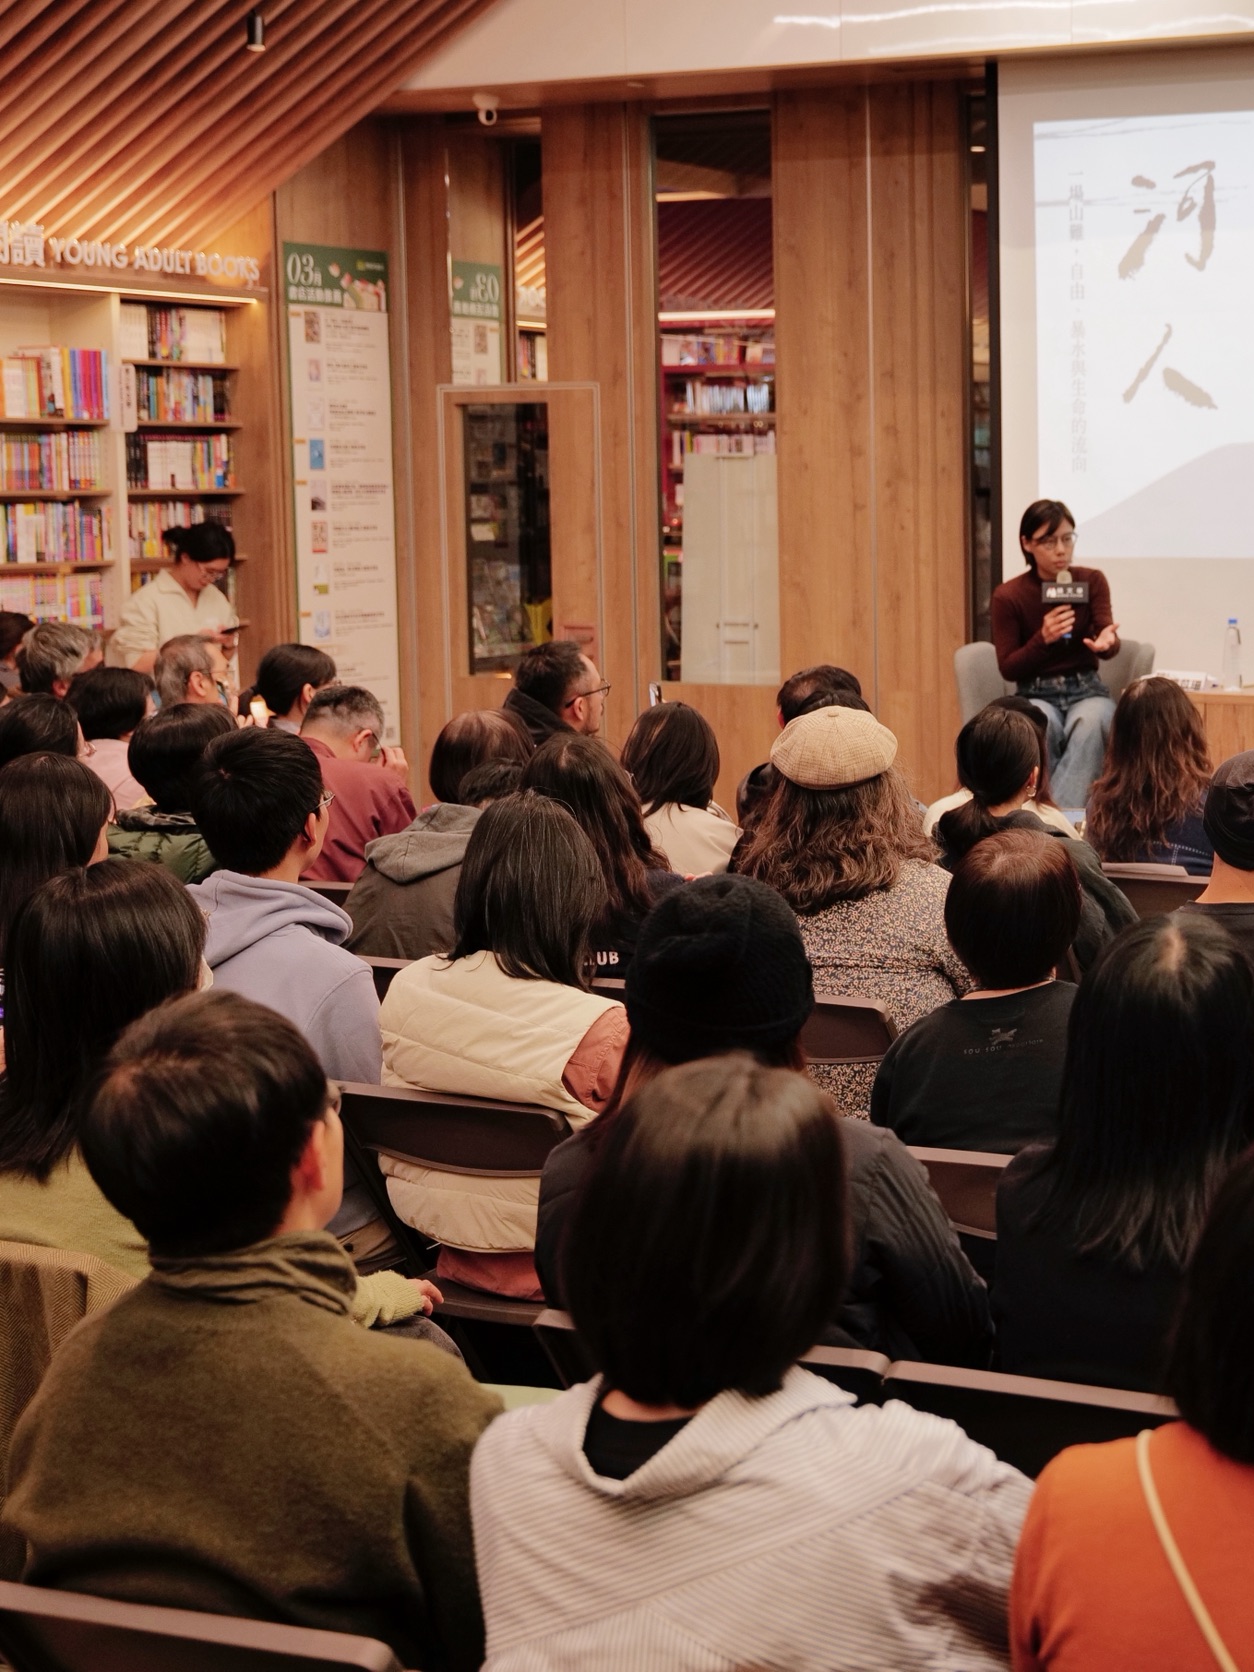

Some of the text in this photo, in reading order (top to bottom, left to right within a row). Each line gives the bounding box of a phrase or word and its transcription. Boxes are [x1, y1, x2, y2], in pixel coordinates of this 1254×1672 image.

[0, 219, 46, 268] 讀
[49, 237, 260, 283] YOUNG ADULT BOOKS
